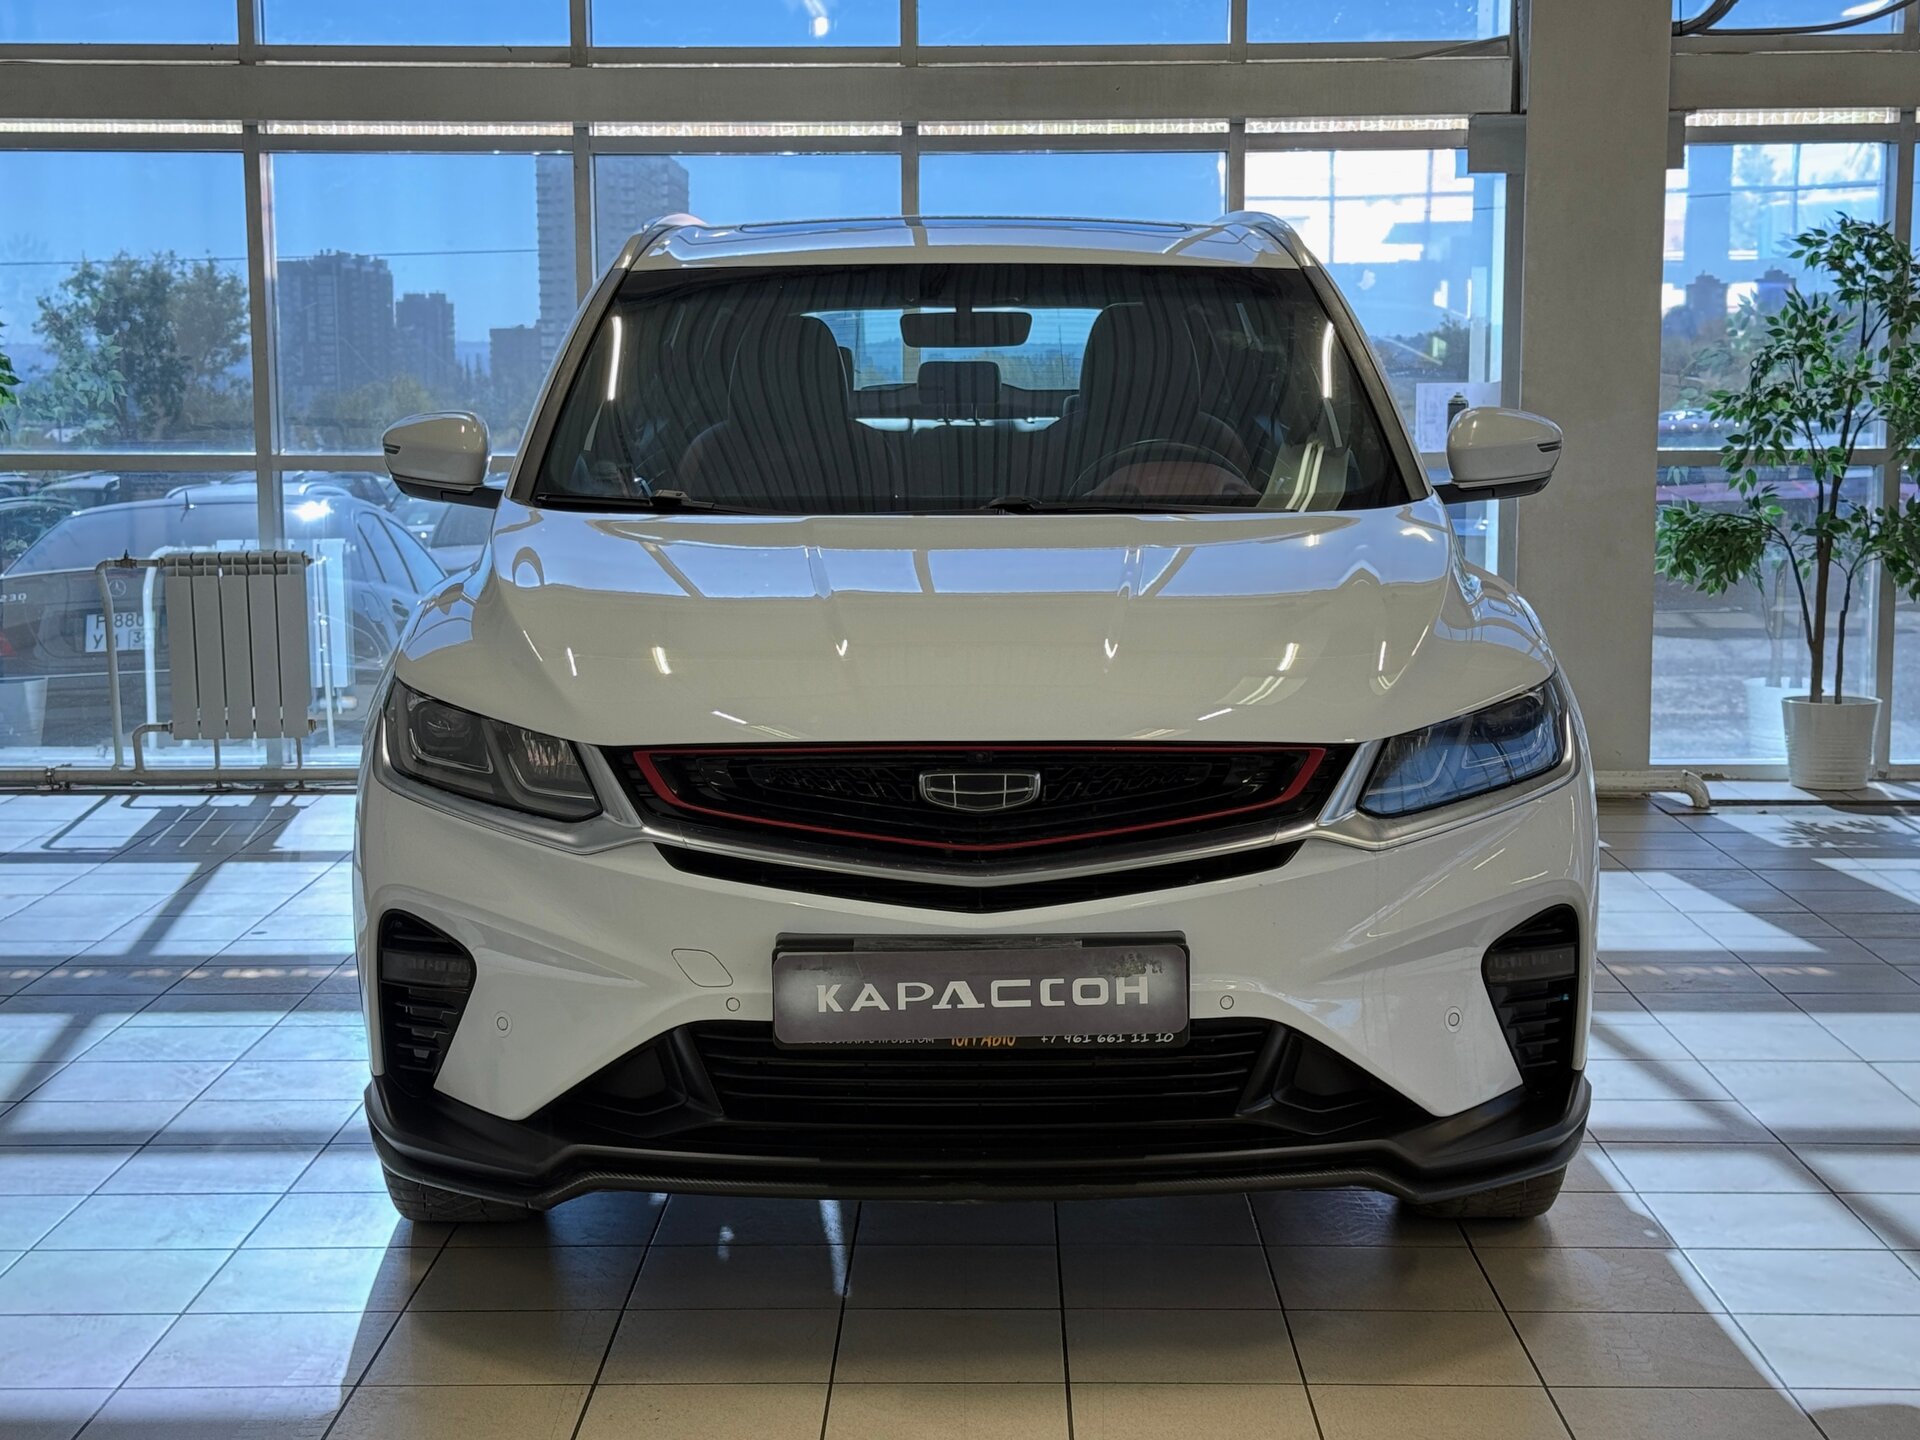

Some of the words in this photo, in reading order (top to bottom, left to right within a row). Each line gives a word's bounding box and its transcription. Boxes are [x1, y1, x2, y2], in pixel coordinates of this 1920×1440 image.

[816, 976, 1149, 1013] КАРАССОН
[1064, 1034, 1092, 1044] 961
[1097, 1033, 1125, 1043] 661
[1131, 1033, 1150, 1043] 11
[1155, 1032, 1174, 1043] 10
